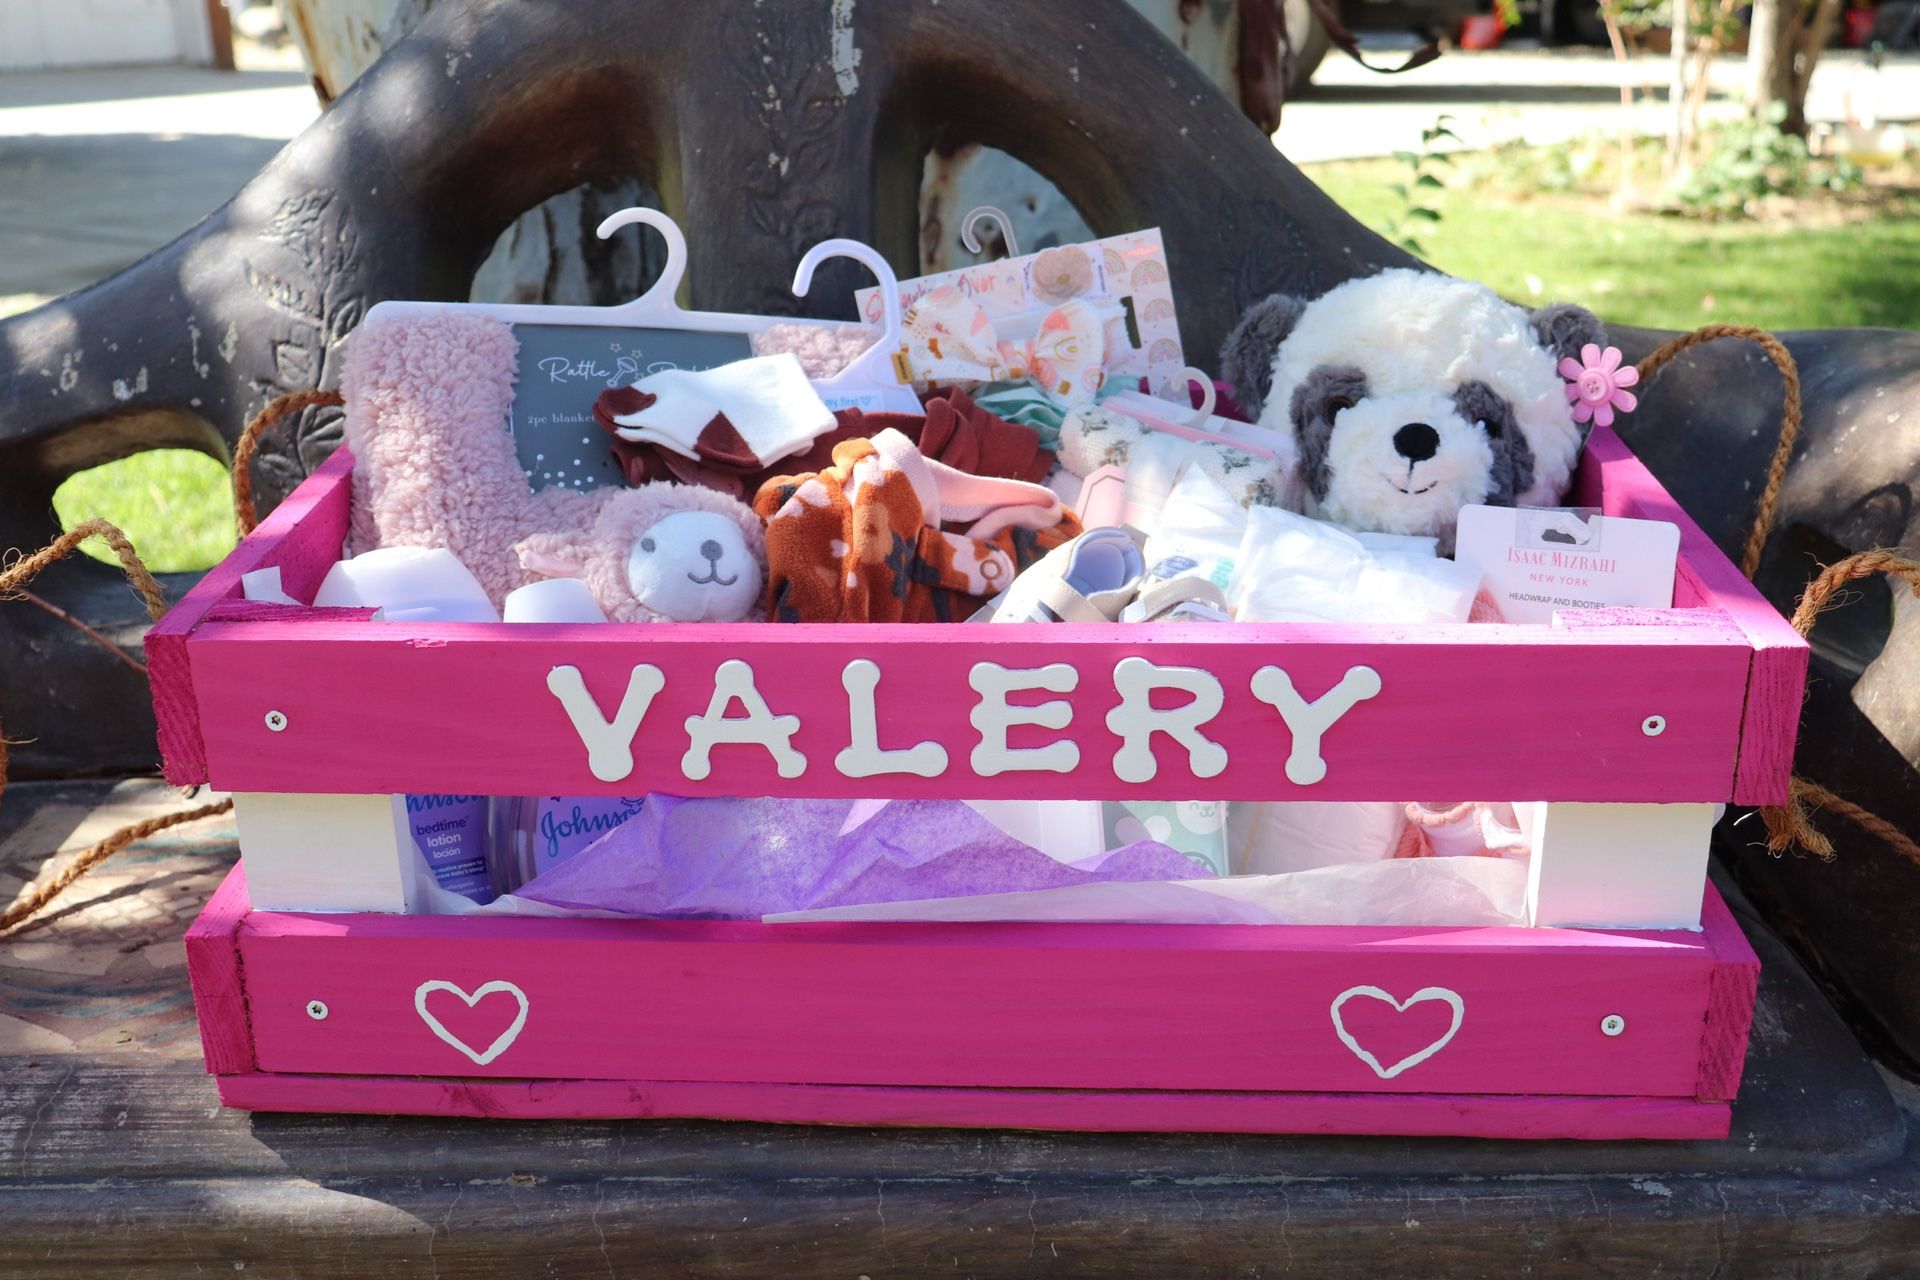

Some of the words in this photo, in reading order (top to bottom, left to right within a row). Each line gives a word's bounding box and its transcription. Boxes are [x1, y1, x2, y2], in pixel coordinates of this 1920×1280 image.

[537, 356, 610, 384] Rattle
[527, 415, 548, 428] 2pc
[1529, 573, 1555, 584] NEW
[1560, 576, 1590, 587] YORK
[1508, 592, 1552, 604] HEADWRAP
[1553, 597, 1571, 607] AND
[1571, 599, 1606, 610] BOOTIES
[546, 656, 1382, 786] VALERY
[416, 819, 467, 836] bedtime
[541, 805, 642, 858] Johnso
[427, 833, 462, 848] lotion
[432, 846, 461, 859] loción
